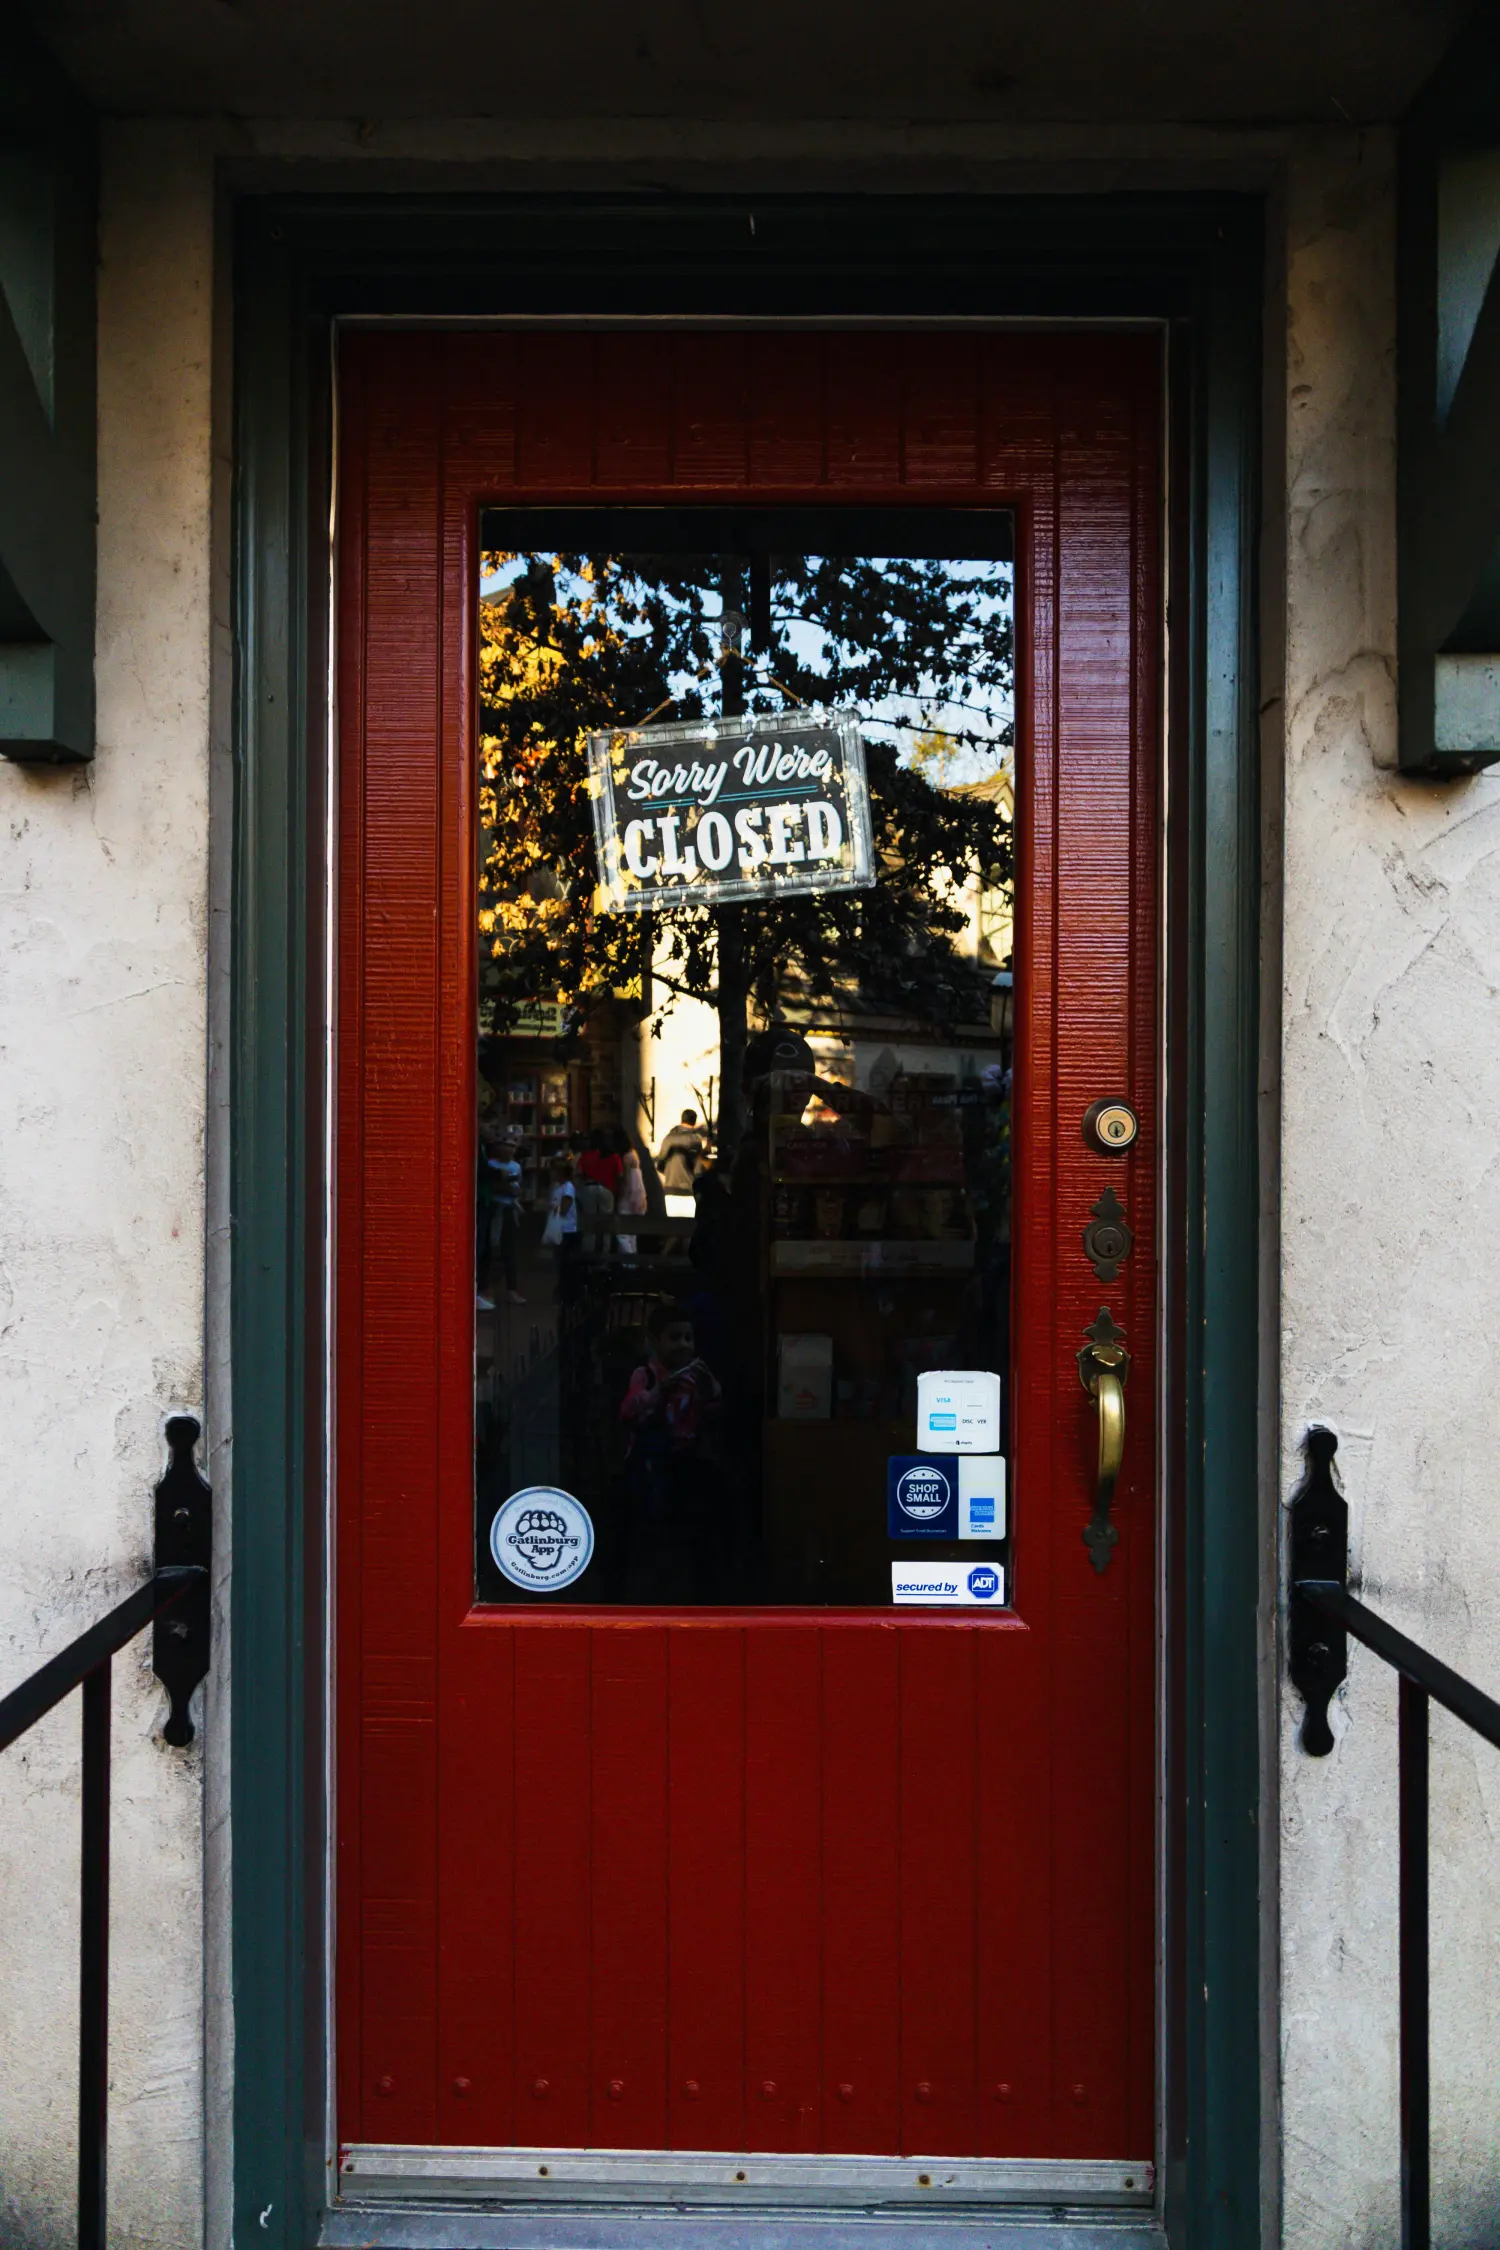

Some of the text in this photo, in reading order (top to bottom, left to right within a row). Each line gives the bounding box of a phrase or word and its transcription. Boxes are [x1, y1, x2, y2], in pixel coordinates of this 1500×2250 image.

[627, 743, 832, 806] Sorry We're
[624, 801, 842, 878] CLOSED
[909, 1484, 939, 1493] SHOP
[906, 1494, 941, 1502] SMALL
[508, 1536, 579, 1546] Gatlinburg
[531, 1545, 554, 1555] App
[511, 1556, 579, 1580] Gatlinburg.com/app
[896, 1577, 995, 1593] secured by ADT
